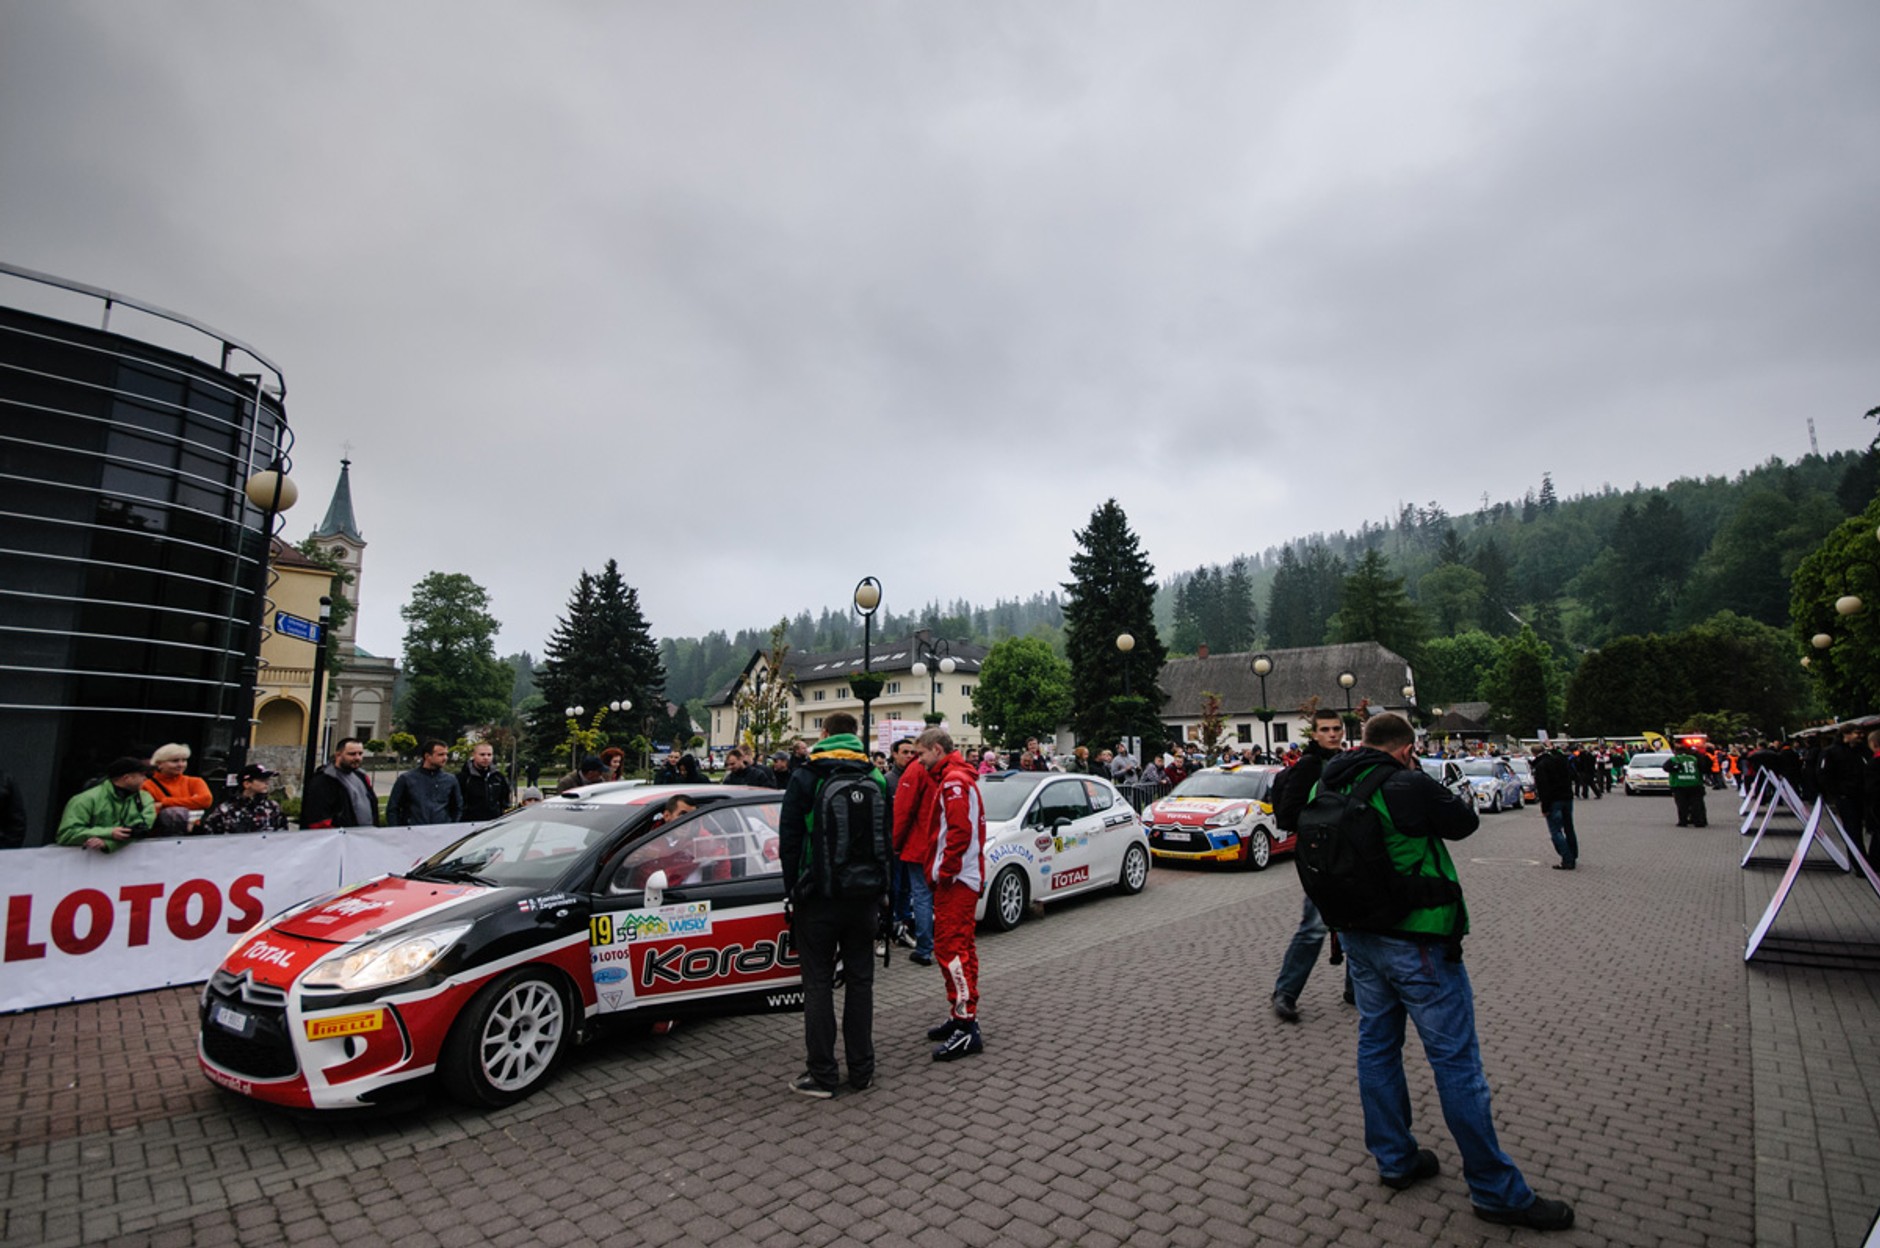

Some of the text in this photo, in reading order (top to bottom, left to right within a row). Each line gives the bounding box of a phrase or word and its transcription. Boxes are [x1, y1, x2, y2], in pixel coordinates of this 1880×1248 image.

[1682, 761, 1696, 774] 15
[989, 844, 1035, 864] MALKOM
[1053, 869, 1089, 887] TOTAL
[4, 873, 265, 963] LOTOS
[590, 915, 613, 946] 19
[616, 926, 638, 943] 59
[243, 941, 296, 968] TOTAL
[599, 949, 630, 962] LOTOS
[313, 1013, 376, 1036] PIRELLI
